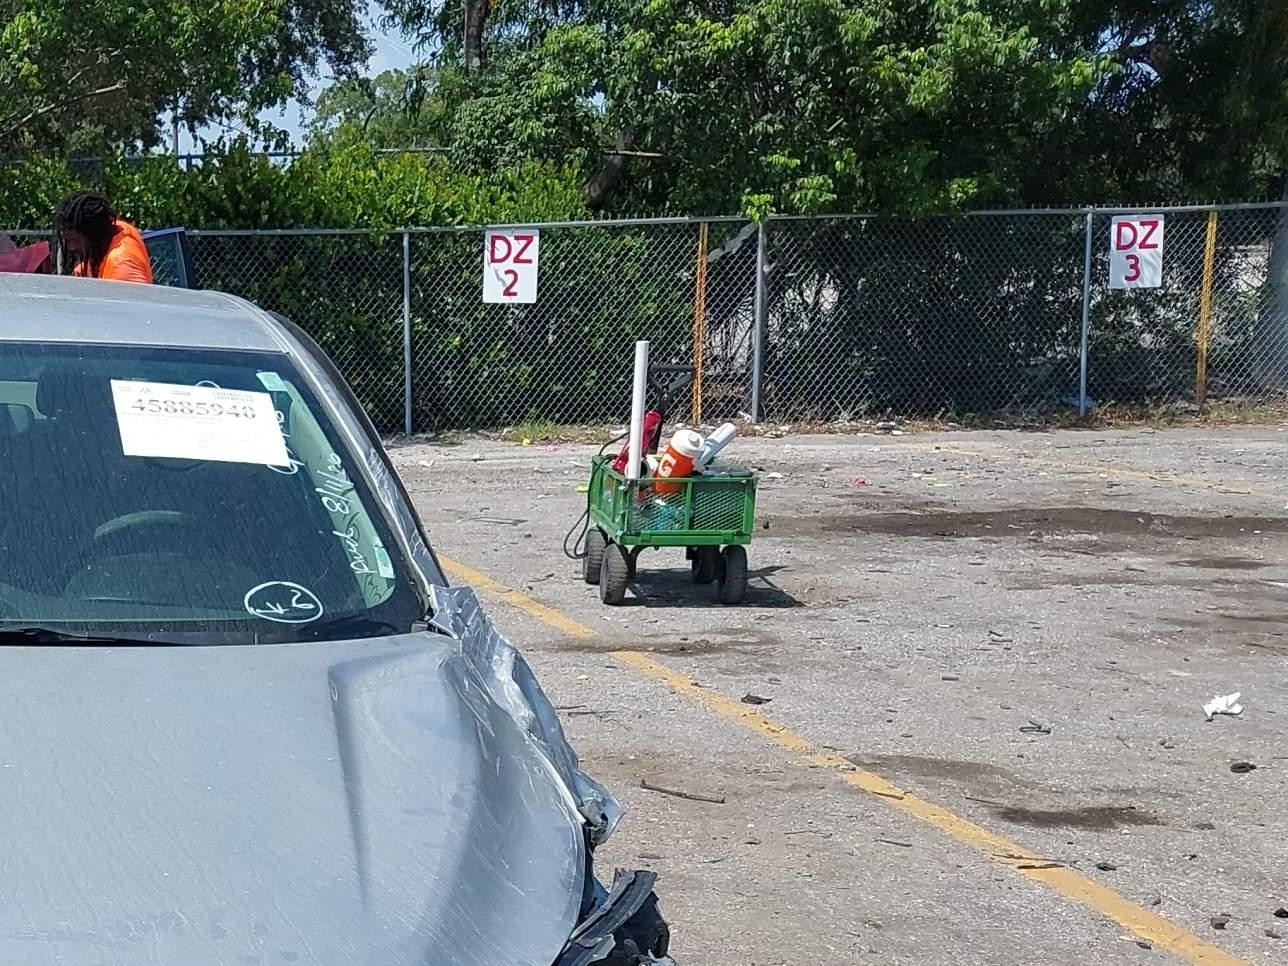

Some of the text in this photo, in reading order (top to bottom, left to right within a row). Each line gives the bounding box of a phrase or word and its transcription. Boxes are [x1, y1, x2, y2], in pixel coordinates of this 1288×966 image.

[1116, 220, 1159, 250] DZ
[489, 235, 534, 264] DZ
[1124, 254, 1141, 282] 3
[502, 269, 519, 297] 2
[131, 397, 257, 420] 45885940
